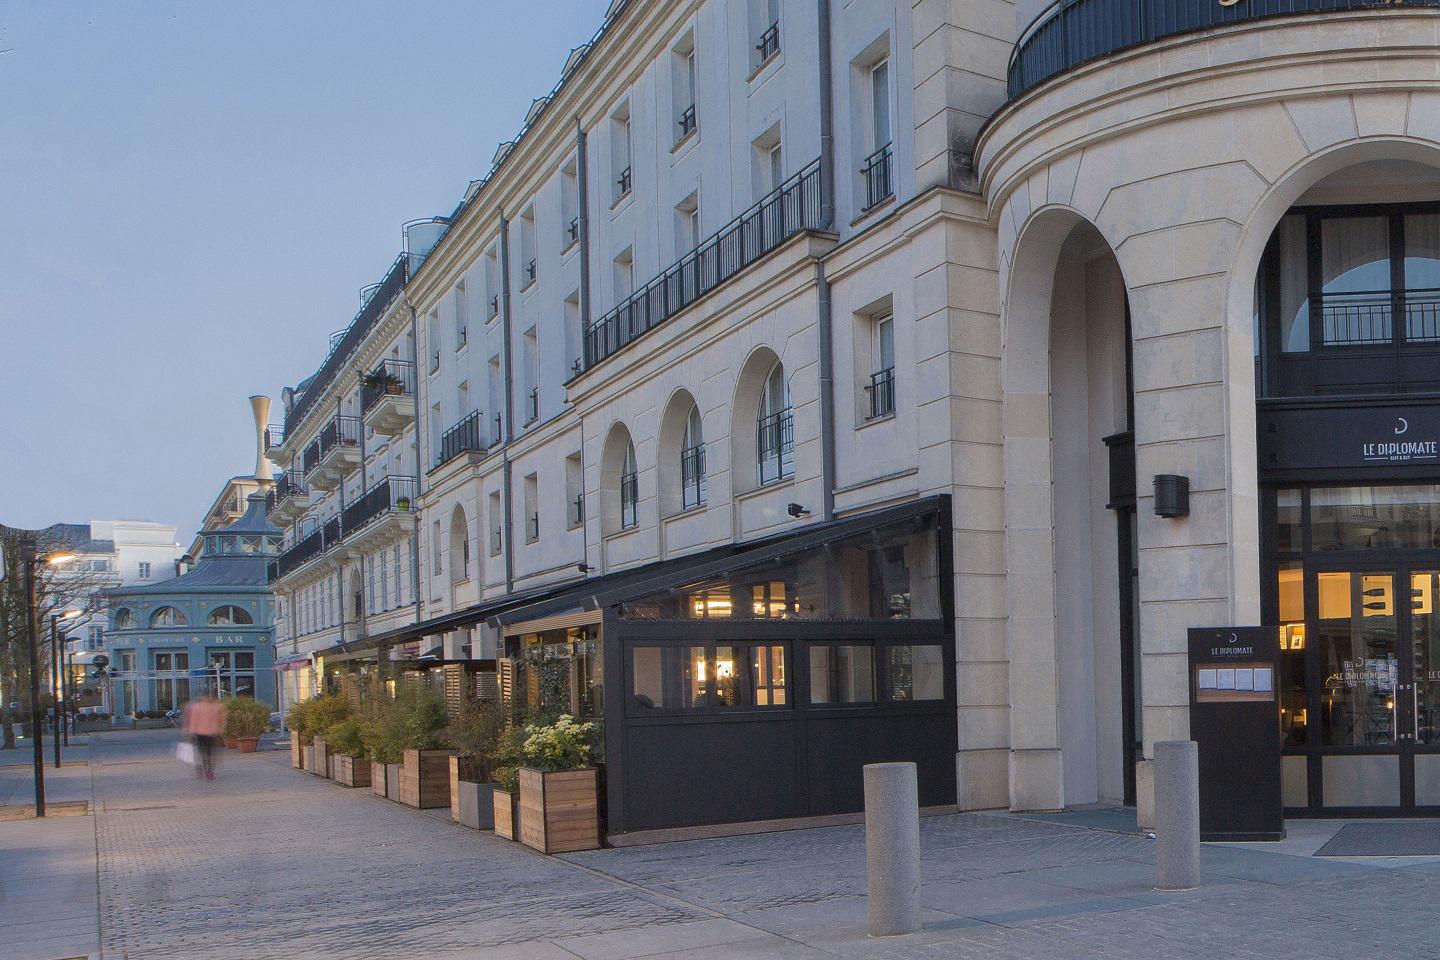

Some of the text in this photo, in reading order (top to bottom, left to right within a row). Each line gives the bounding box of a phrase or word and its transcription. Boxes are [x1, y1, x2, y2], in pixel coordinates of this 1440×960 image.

[1363, 441, 1438, 456] LE DIPLOMATE
[215, 635, 245, 644] BAR
[1211, 646, 1254, 655] LE DIPLOMATE
[1428, 671, 1435, 679] LE
